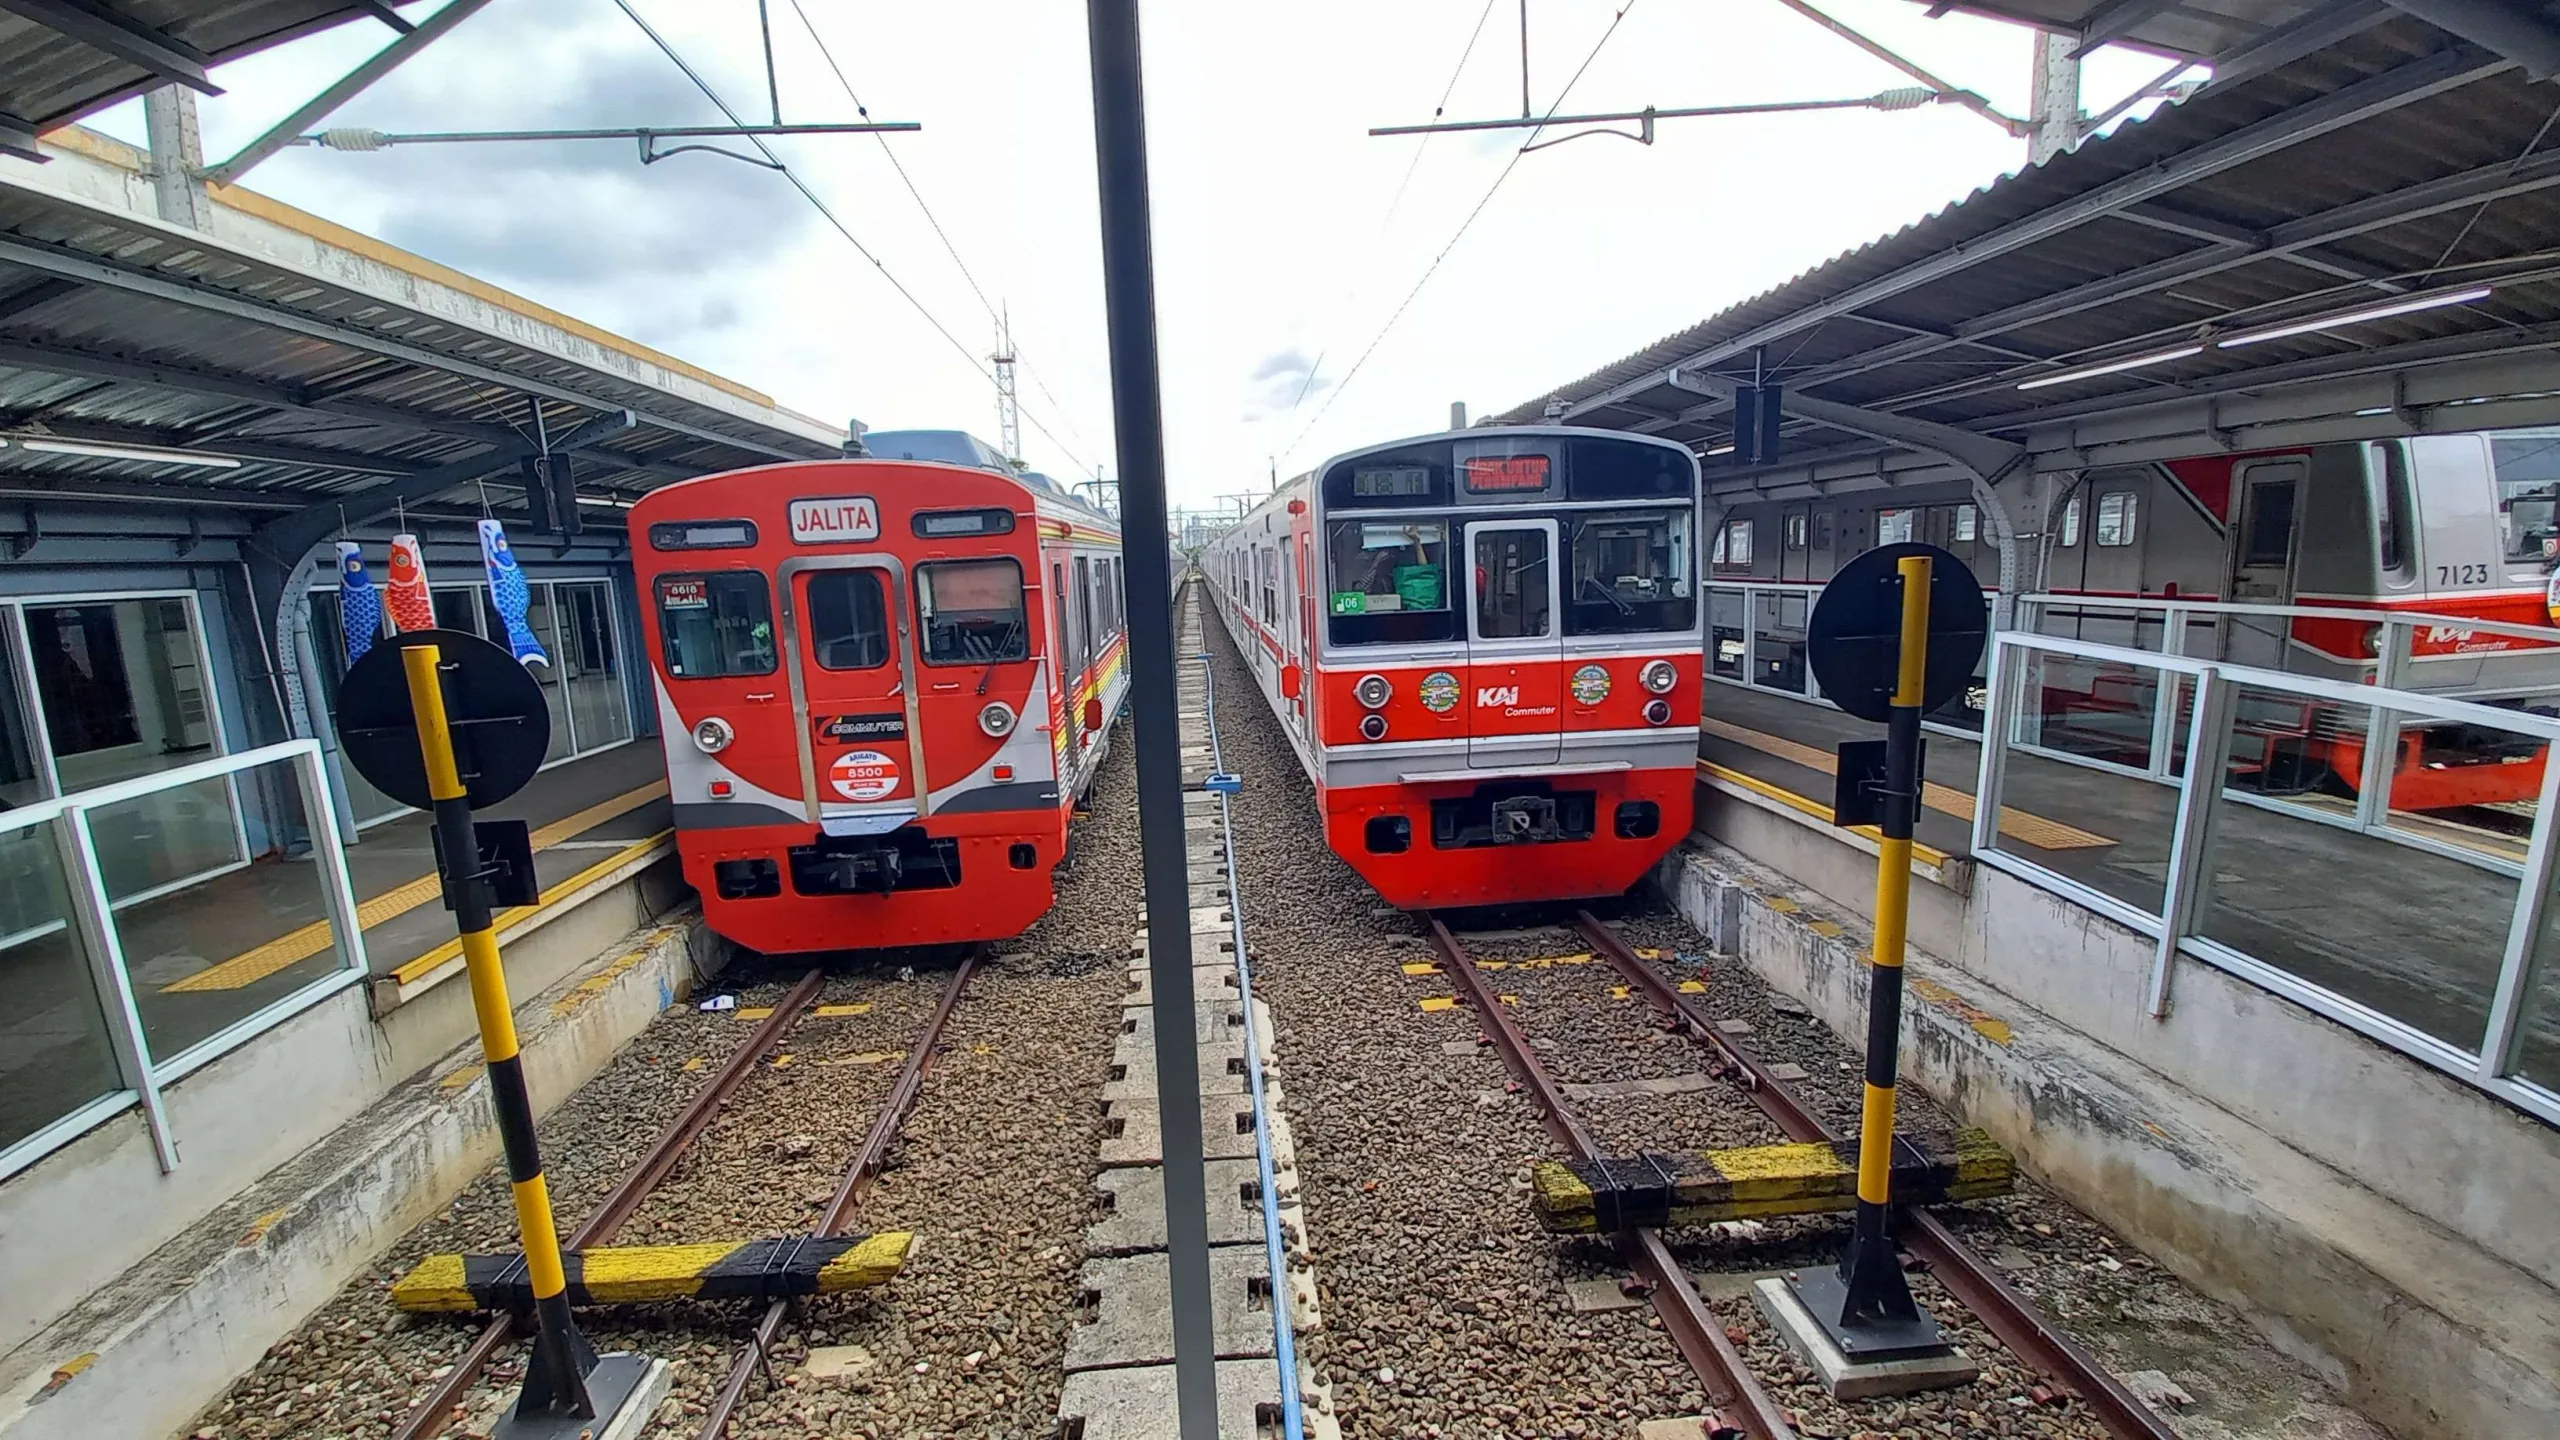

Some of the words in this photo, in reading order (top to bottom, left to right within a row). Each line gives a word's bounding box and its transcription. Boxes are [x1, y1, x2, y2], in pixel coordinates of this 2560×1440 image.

[797, 505, 872, 532] JALITA
[2437, 564, 2488, 586] 7123
[2455, 641, 2510, 653] Commuter
[1477, 686, 1519, 708] KAI
[1505, 706, 1556, 717] Commuter
[849, 753, 877, 762] ARIGATO
[848, 767, 883, 779] 8500
